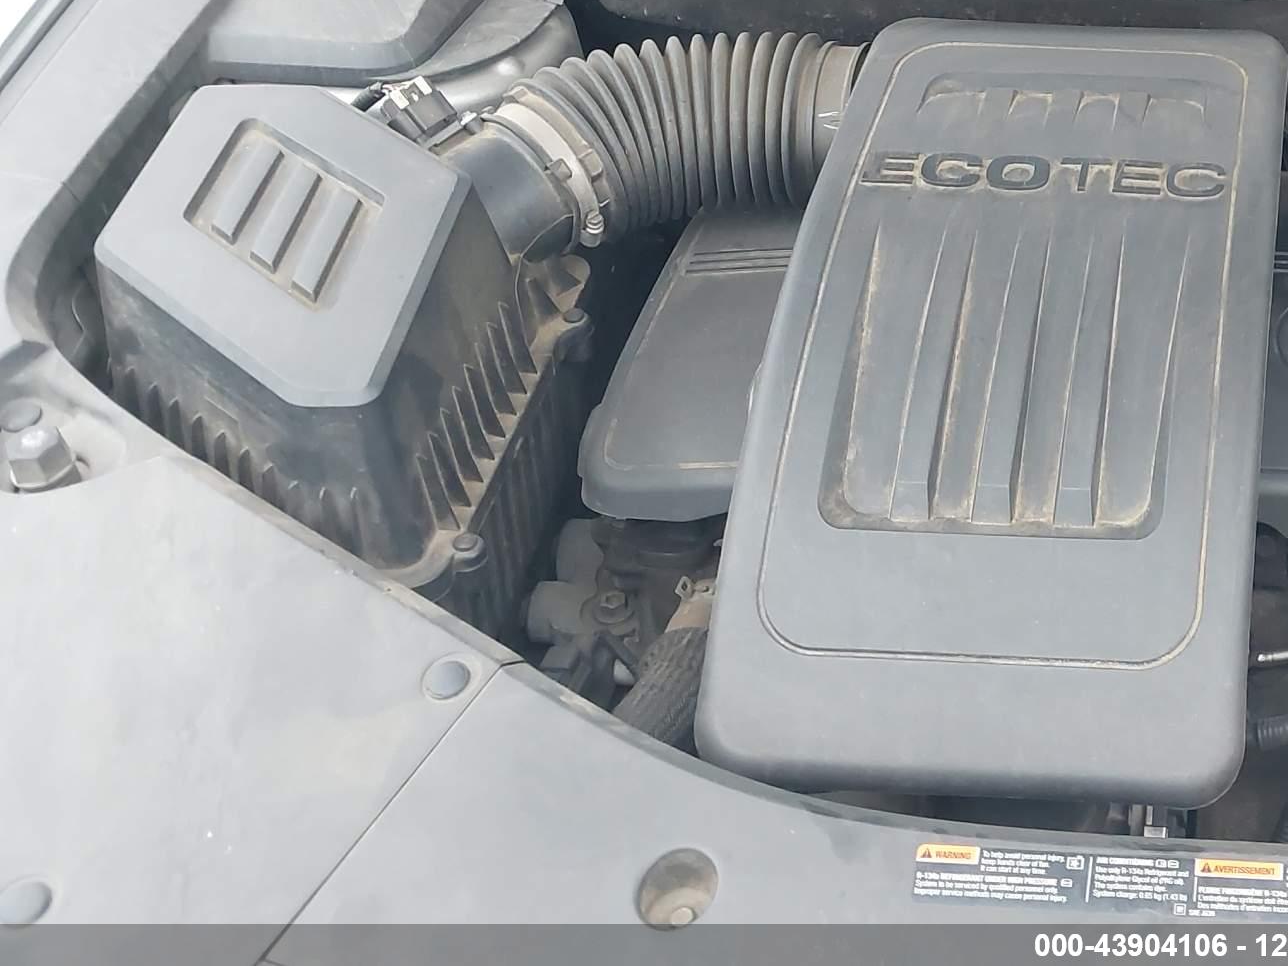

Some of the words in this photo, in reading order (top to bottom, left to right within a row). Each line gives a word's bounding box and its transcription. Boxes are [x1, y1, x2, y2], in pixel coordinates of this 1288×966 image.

[860, 151, 1227, 199] ECOTEC
[936, 850, 971, 859] WARNING
[1213, 865, 1275, 875] AVERTISSEMENT
